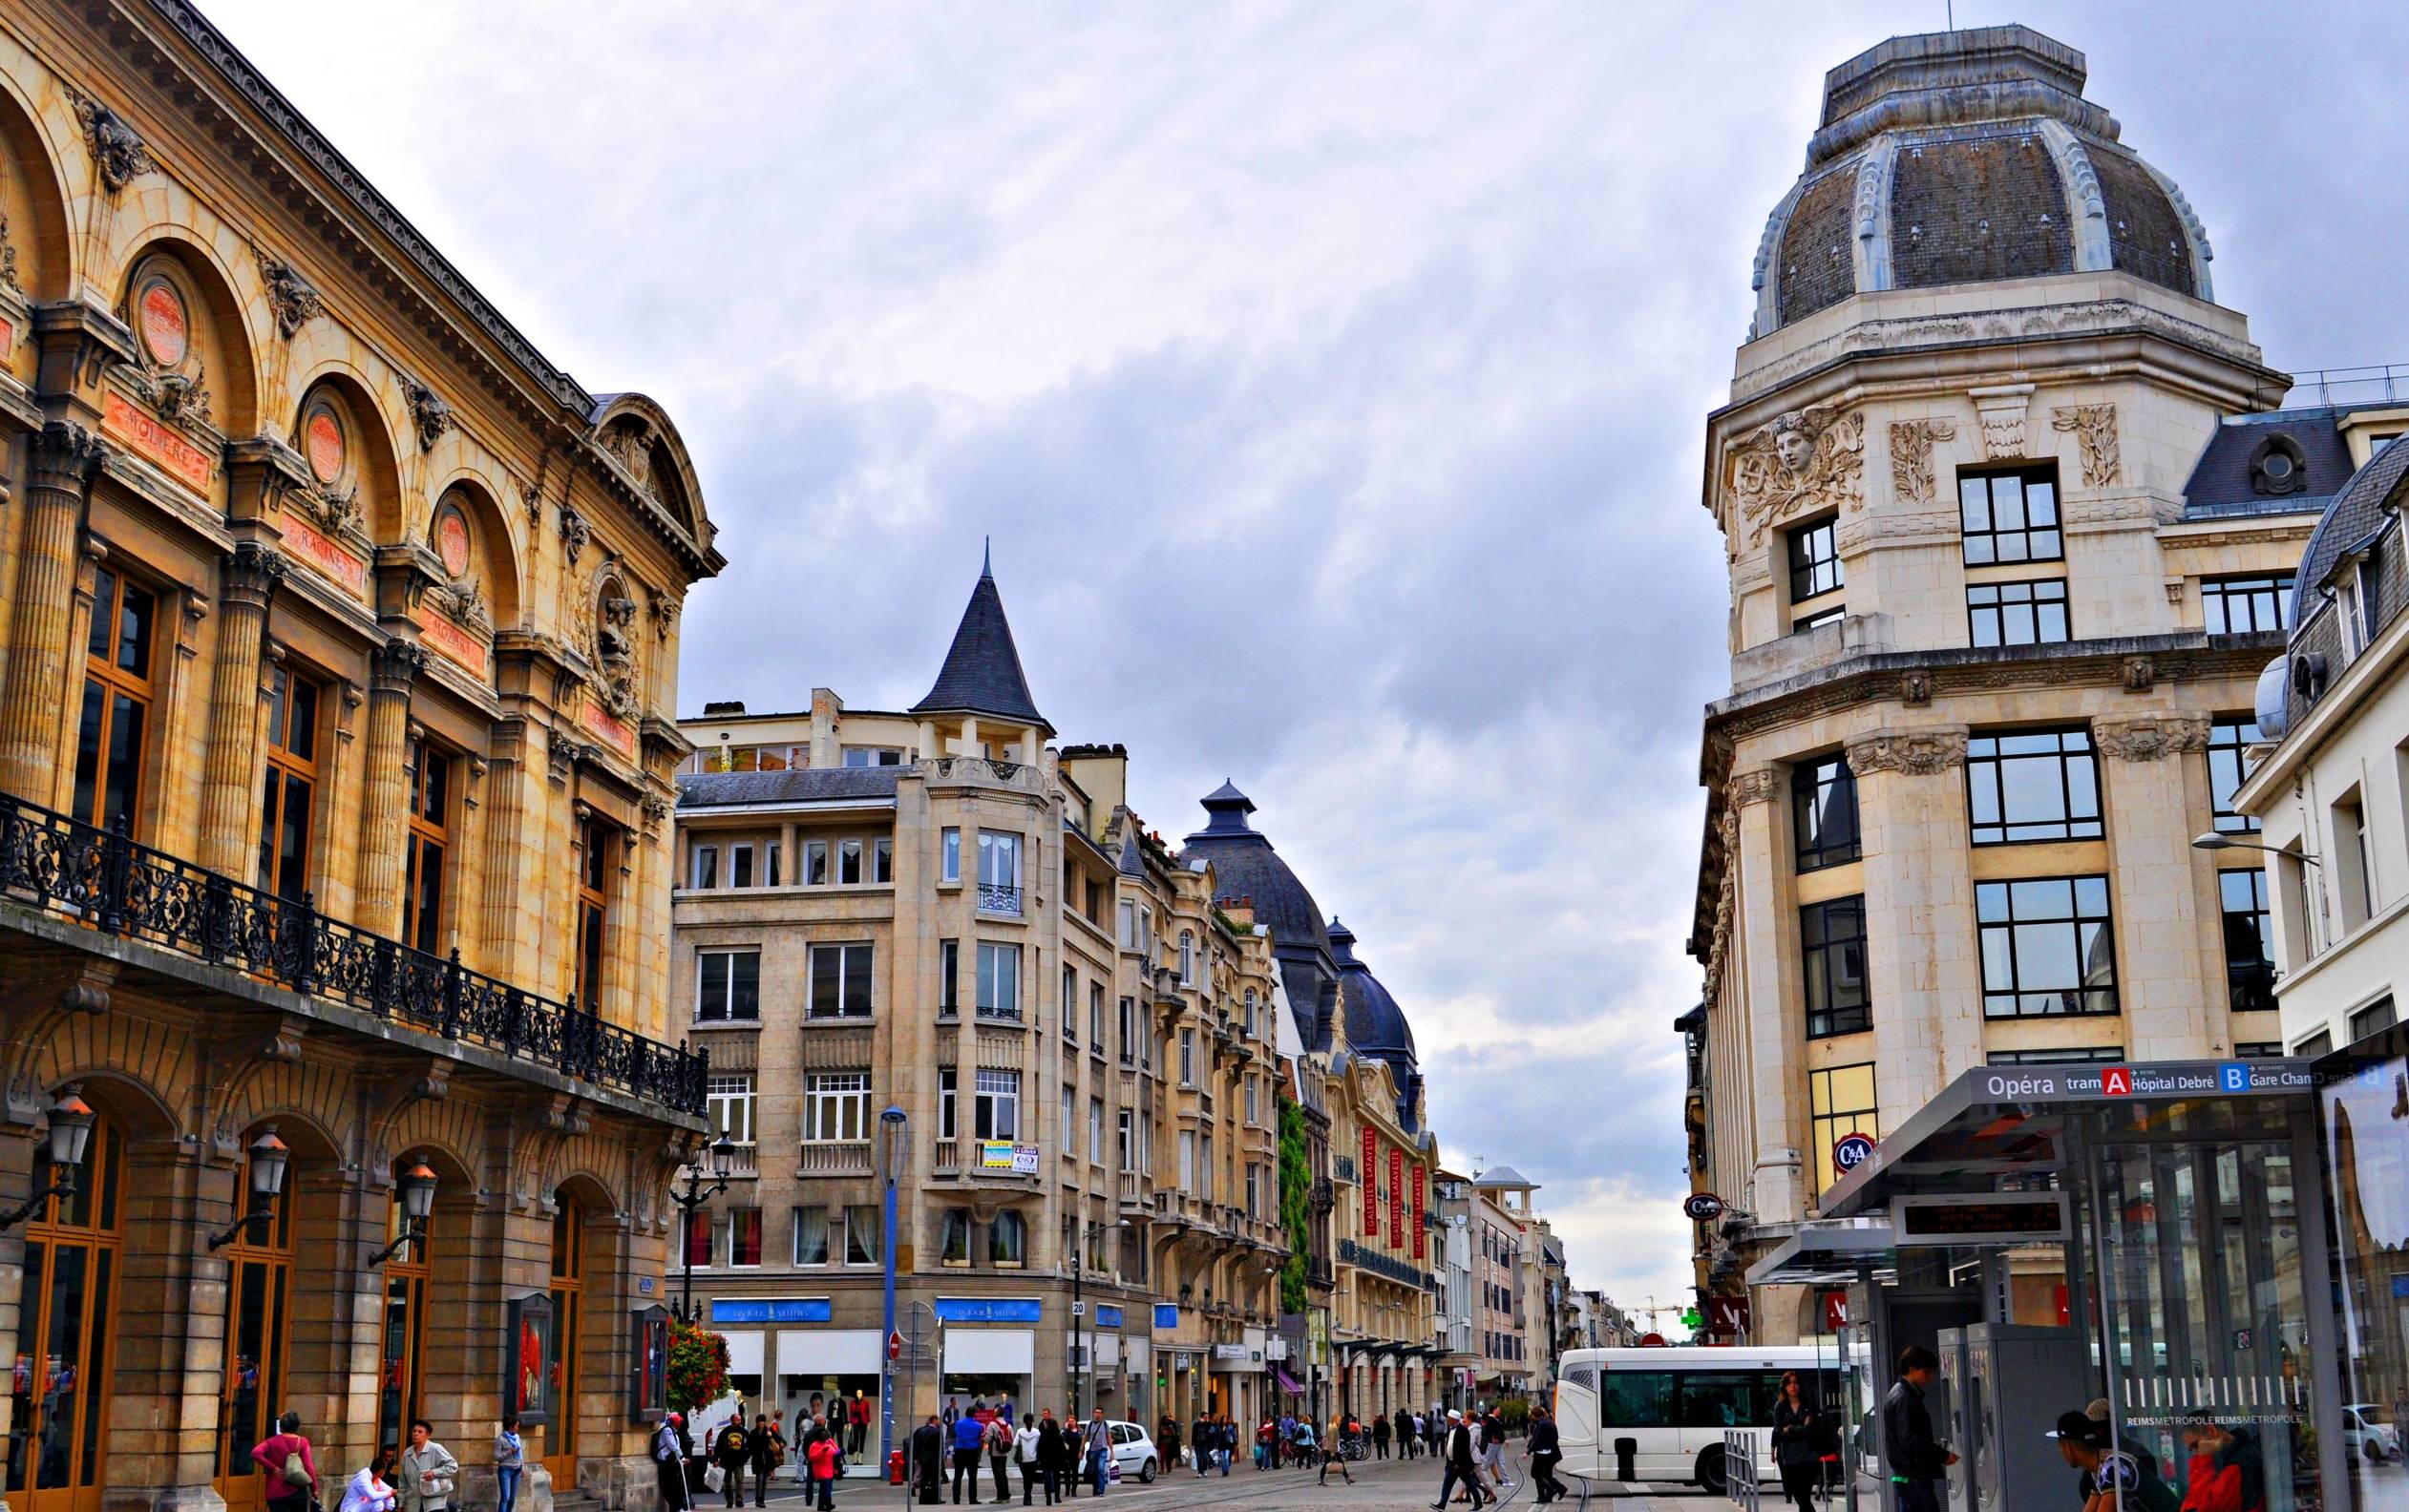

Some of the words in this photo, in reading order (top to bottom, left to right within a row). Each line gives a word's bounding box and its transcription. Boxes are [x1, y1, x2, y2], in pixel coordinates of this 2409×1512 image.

[302, 530, 343, 571] RACINE
[1988, 1075, 2055, 1100] Opéra
[2066, 1078, 2102, 1090] tram
[2106, 1072, 2127, 1094] A
[2131, 1076, 2175, 1093] Hôpital
[2178, 1075, 2214, 1089] Debré
[2227, 1068, 2243, 1089] B
[2250, 1074, 2278, 1086] Gare
[1365, 1129, 1374, 1178] LAFAYETTE
[1839, 1144, 1866, 1165] C&A
[1366, 1183, 1375, 1228] GALERIES
[1073, 1304, 1084, 1313] 20
